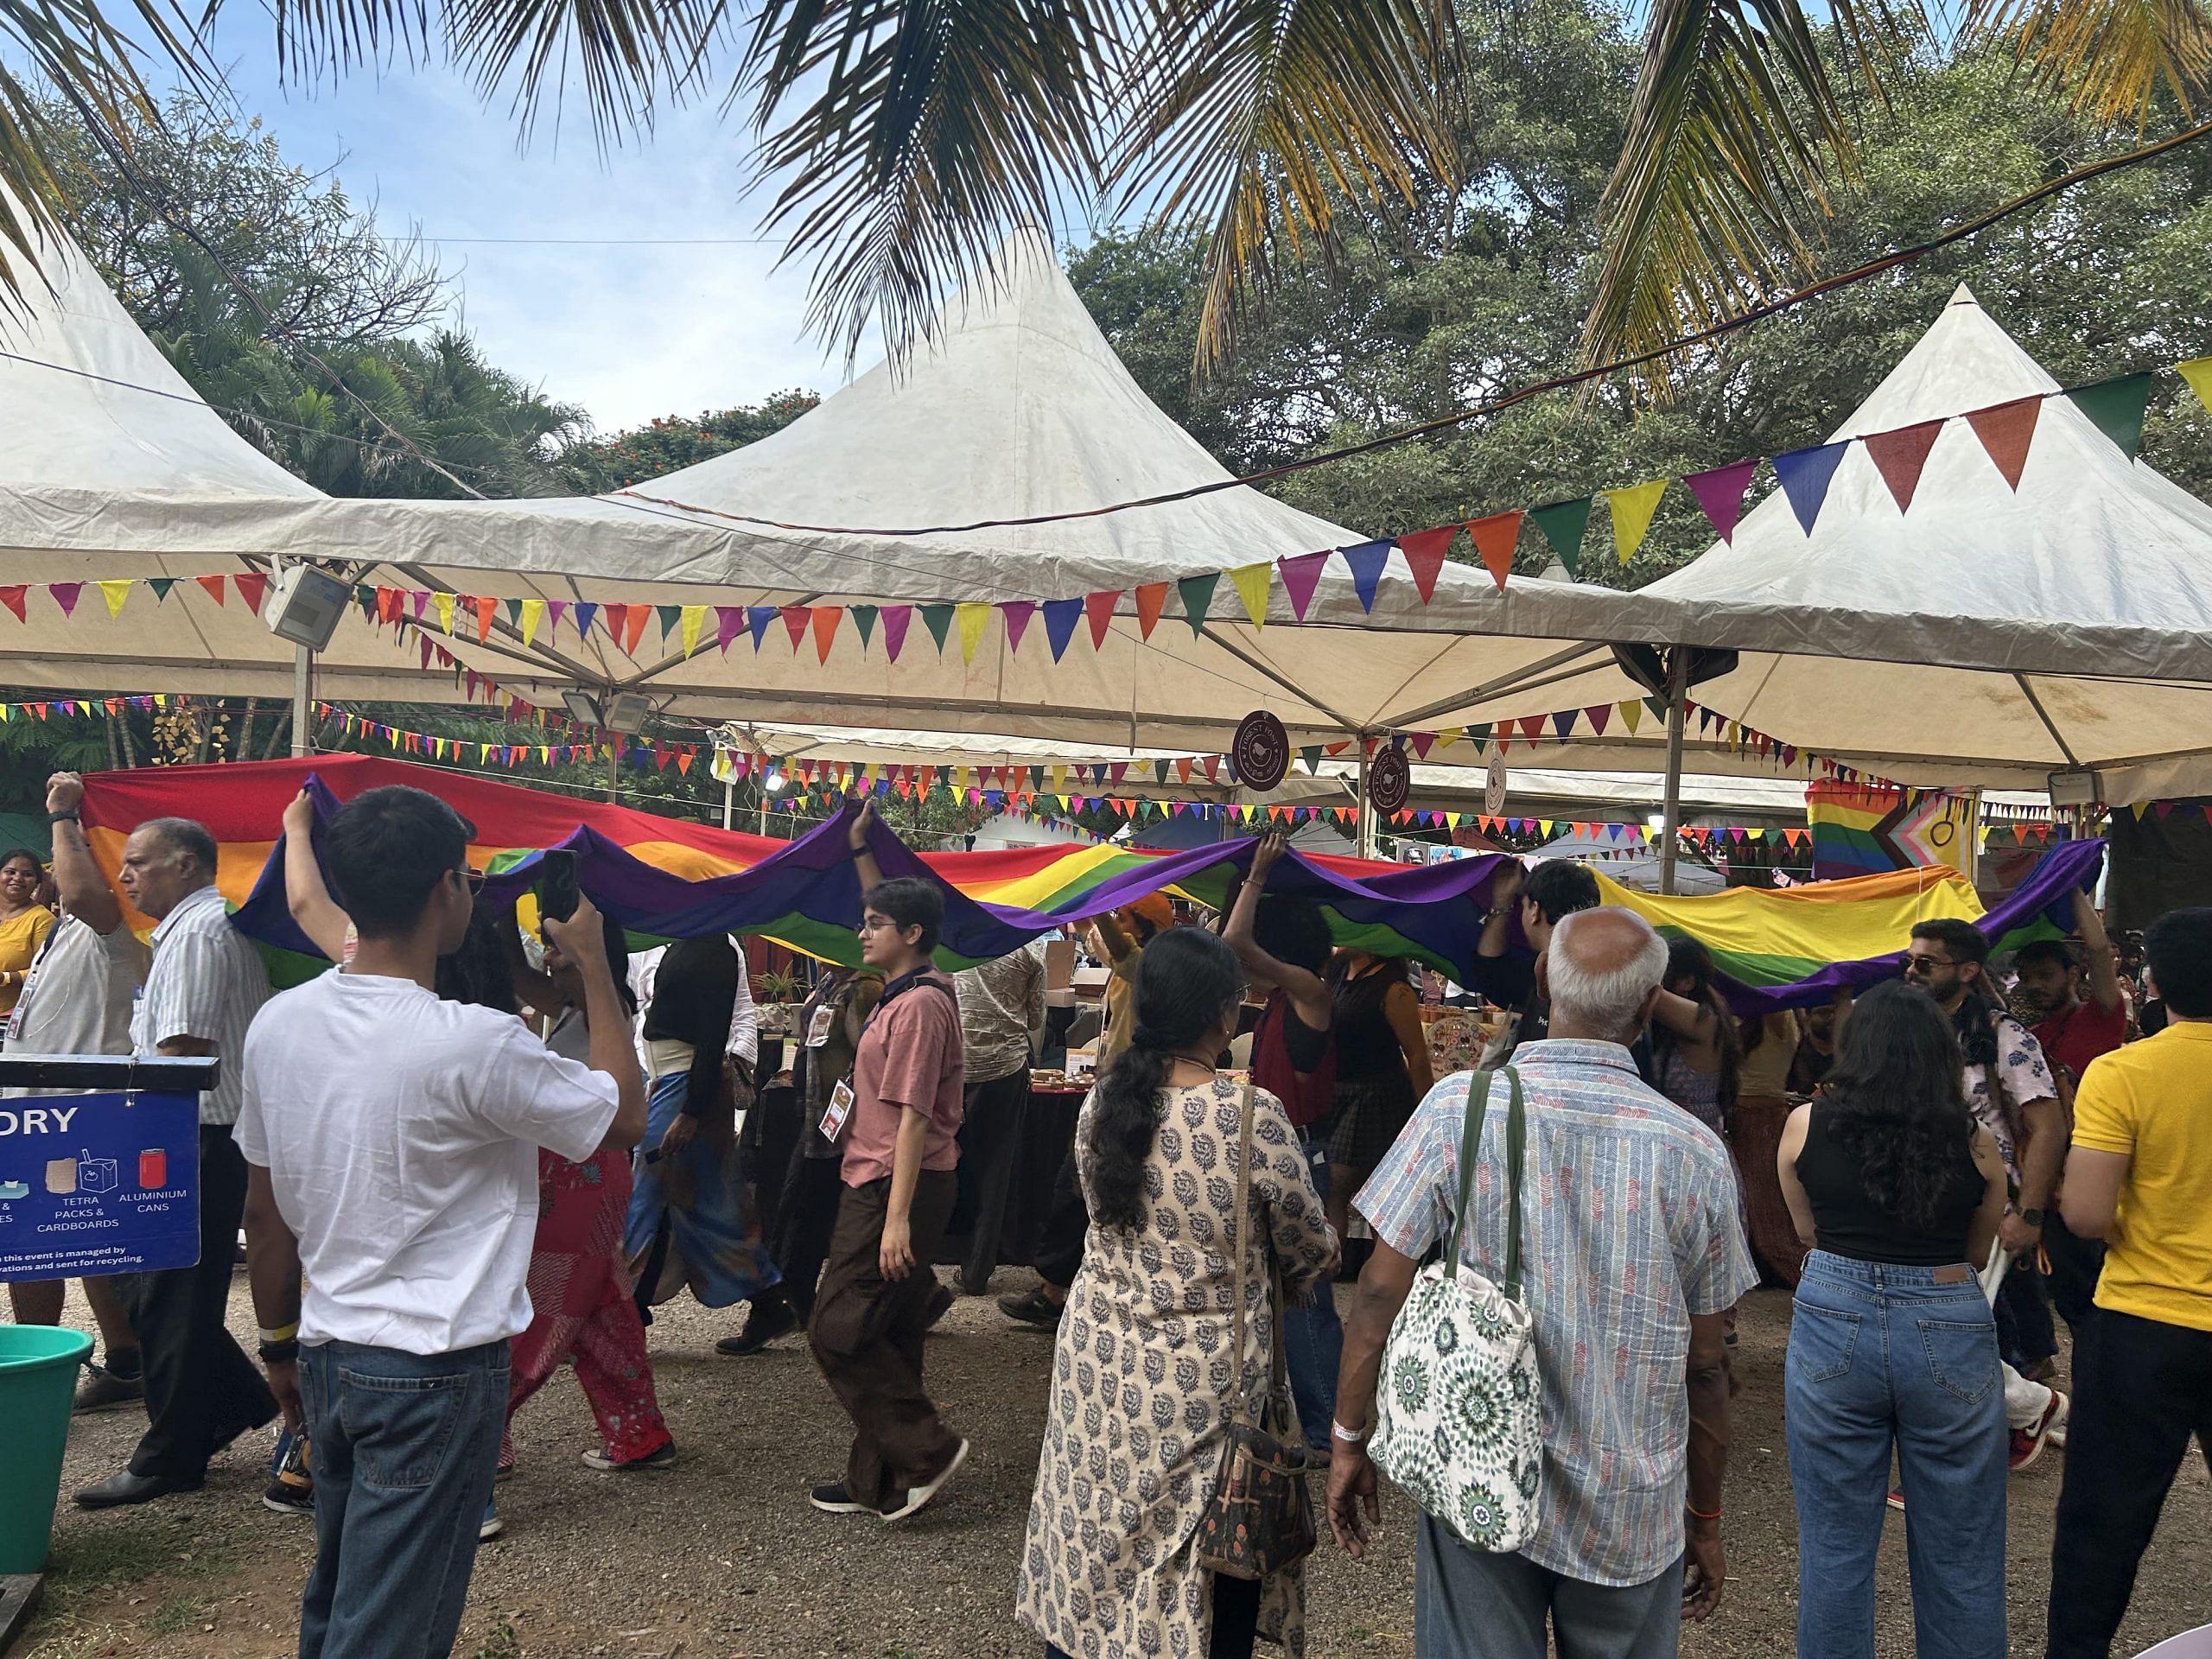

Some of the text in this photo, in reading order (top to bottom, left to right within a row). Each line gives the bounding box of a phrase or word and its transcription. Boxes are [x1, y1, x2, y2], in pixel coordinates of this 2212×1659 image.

[1242, 724, 1263, 750] FOREST
[0, 1107, 79, 1136] DRY
[62, 1197, 99, 1206] TETRA
[119, 1190, 187, 1203] ALUMINIUM
[54, 1209, 93, 1219] PACKS
[137, 1203, 169, 1213] CANS
[37, 1219, 119, 1233] CARDBOARDS
[24, 1252, 54, 1261] event
[66, 1247, 111, 1257] managed
[35, 1262, 54, 1270] and
[97, 1255, 144, 1266] recycling.
